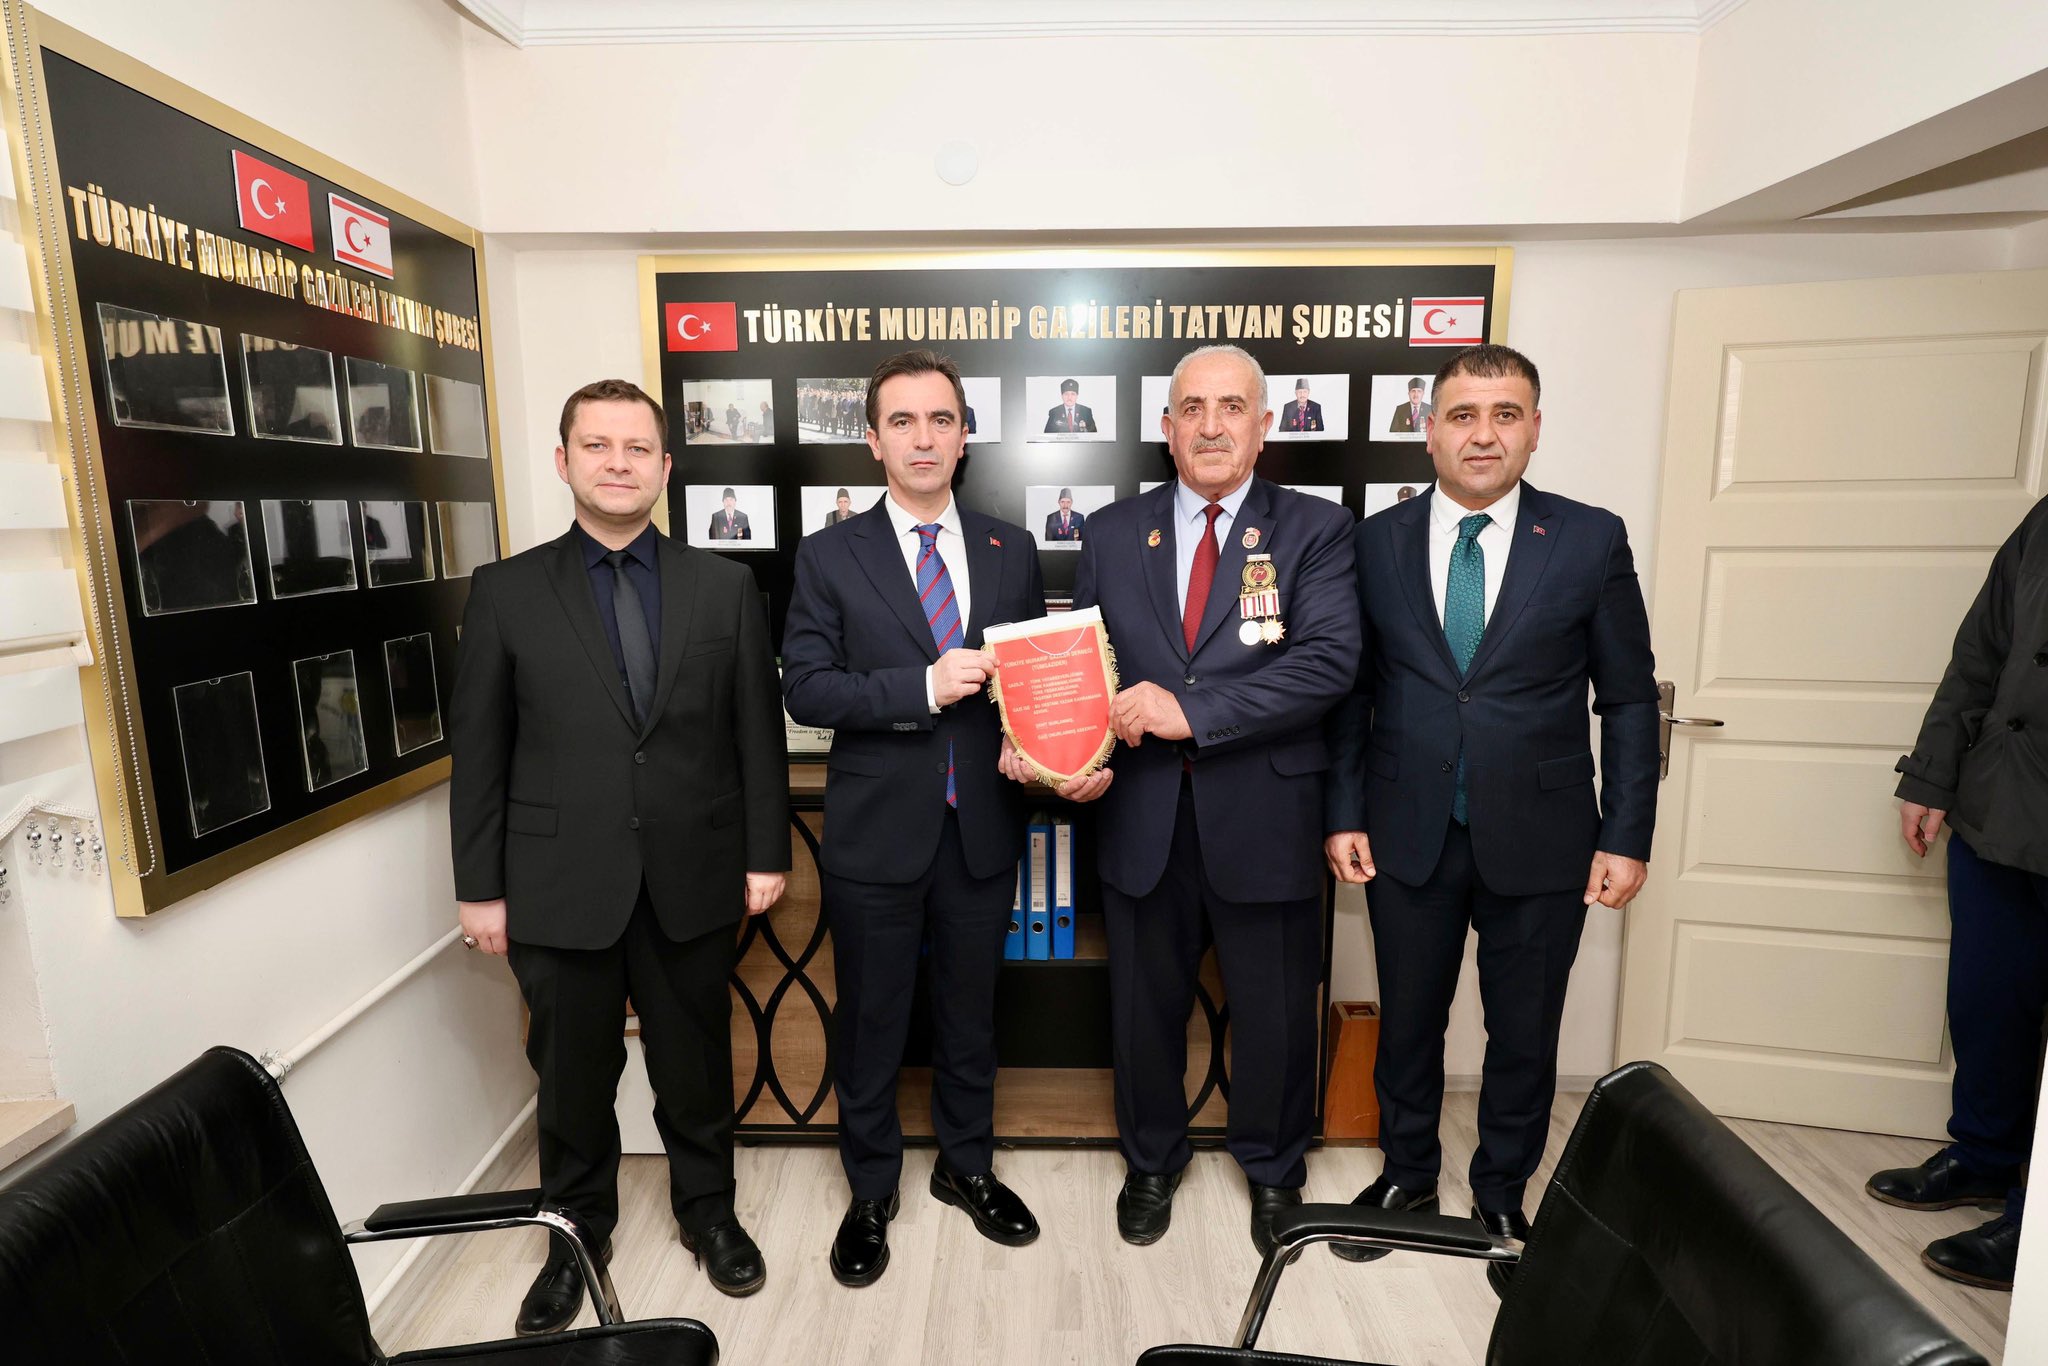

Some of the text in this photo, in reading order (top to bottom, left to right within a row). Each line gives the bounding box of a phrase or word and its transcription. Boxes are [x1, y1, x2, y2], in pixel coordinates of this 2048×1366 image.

[67, 182, 480, 352] TÜRKİYE MUHARİP GAZİLERİ TATVAN ŞUBESİ
[743, 298, 1404, 345] TÜRKİYE MUHARİP GAZİLERİ TATVAN ŞUBESİ
